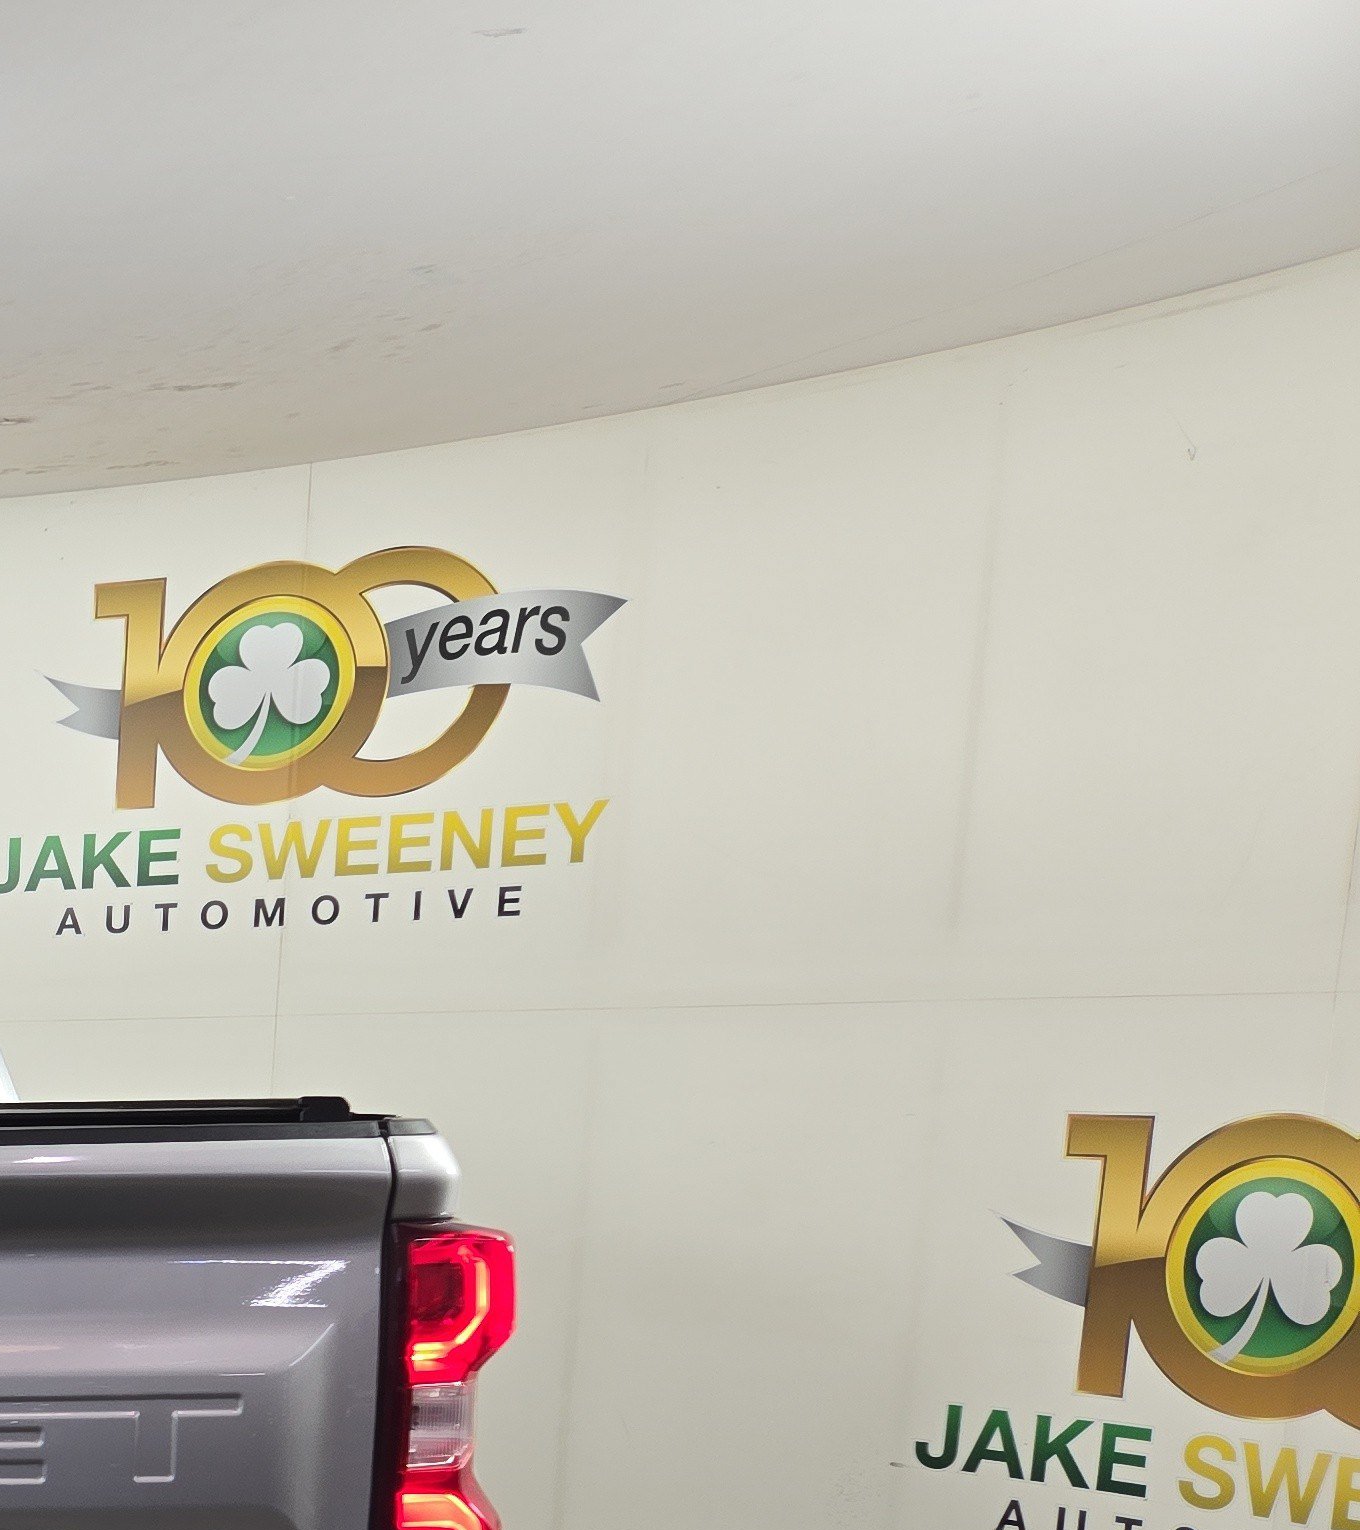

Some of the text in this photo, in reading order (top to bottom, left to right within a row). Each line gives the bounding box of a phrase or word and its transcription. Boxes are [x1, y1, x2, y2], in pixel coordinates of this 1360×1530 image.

[94, 546, 513, 811] 100
[400, 604, 571, 686] years
[205, 799, 610, 884] SWEENEY
[55, 885, 523, 937] AUTOMOTIVE
[914, 1403, 1153, 1499] JAKE
